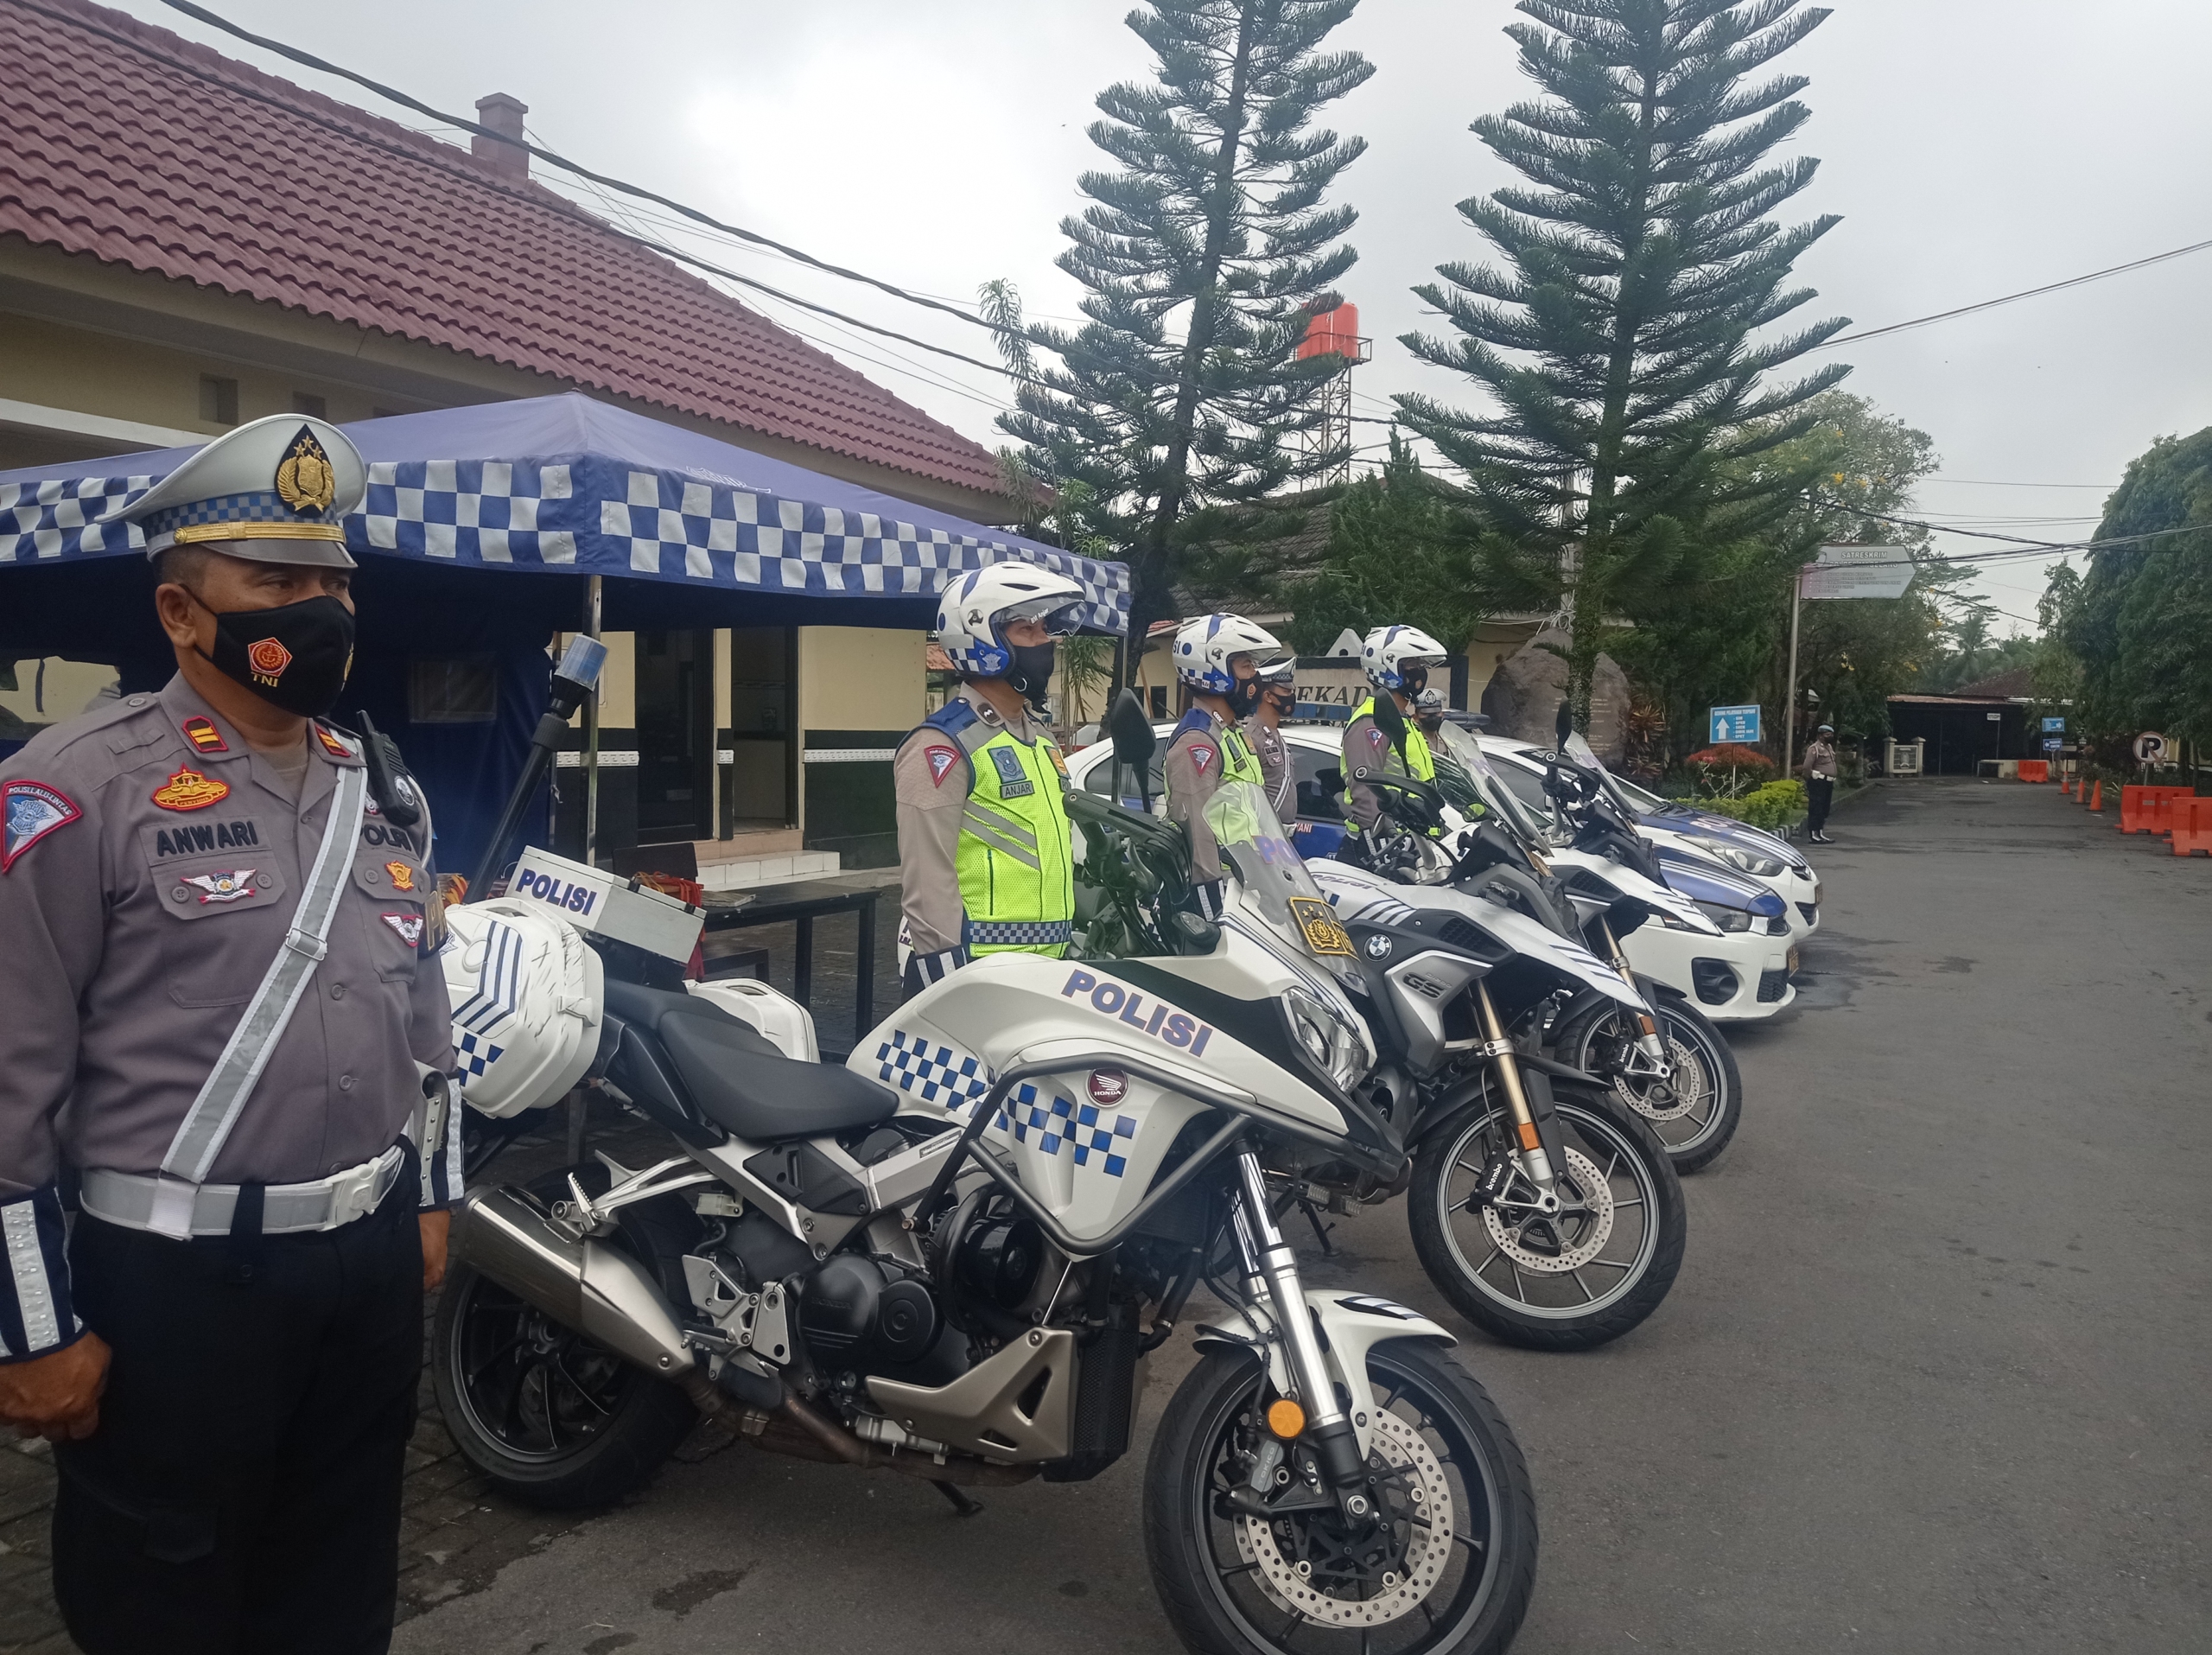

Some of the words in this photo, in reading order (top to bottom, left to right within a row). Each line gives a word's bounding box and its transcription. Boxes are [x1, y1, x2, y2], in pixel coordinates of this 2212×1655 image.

[251, 672, 278, 687] TNI
[2141, 737, 2162, 759] P
[1005, 783, 1032, 797] ANJAR
[156, 821, 259, 857] ANWARI
[360, 824, 412, 852] OLRI
[515, 868, 598, 916] POLISI
[1402, 971, 1446, 999] GS
[1061, 969, 1213, 1058] POLISI
[1485, 1163, 1503, 1191] brembo
[1257, 1447, 1275, 1485] TOKICO
